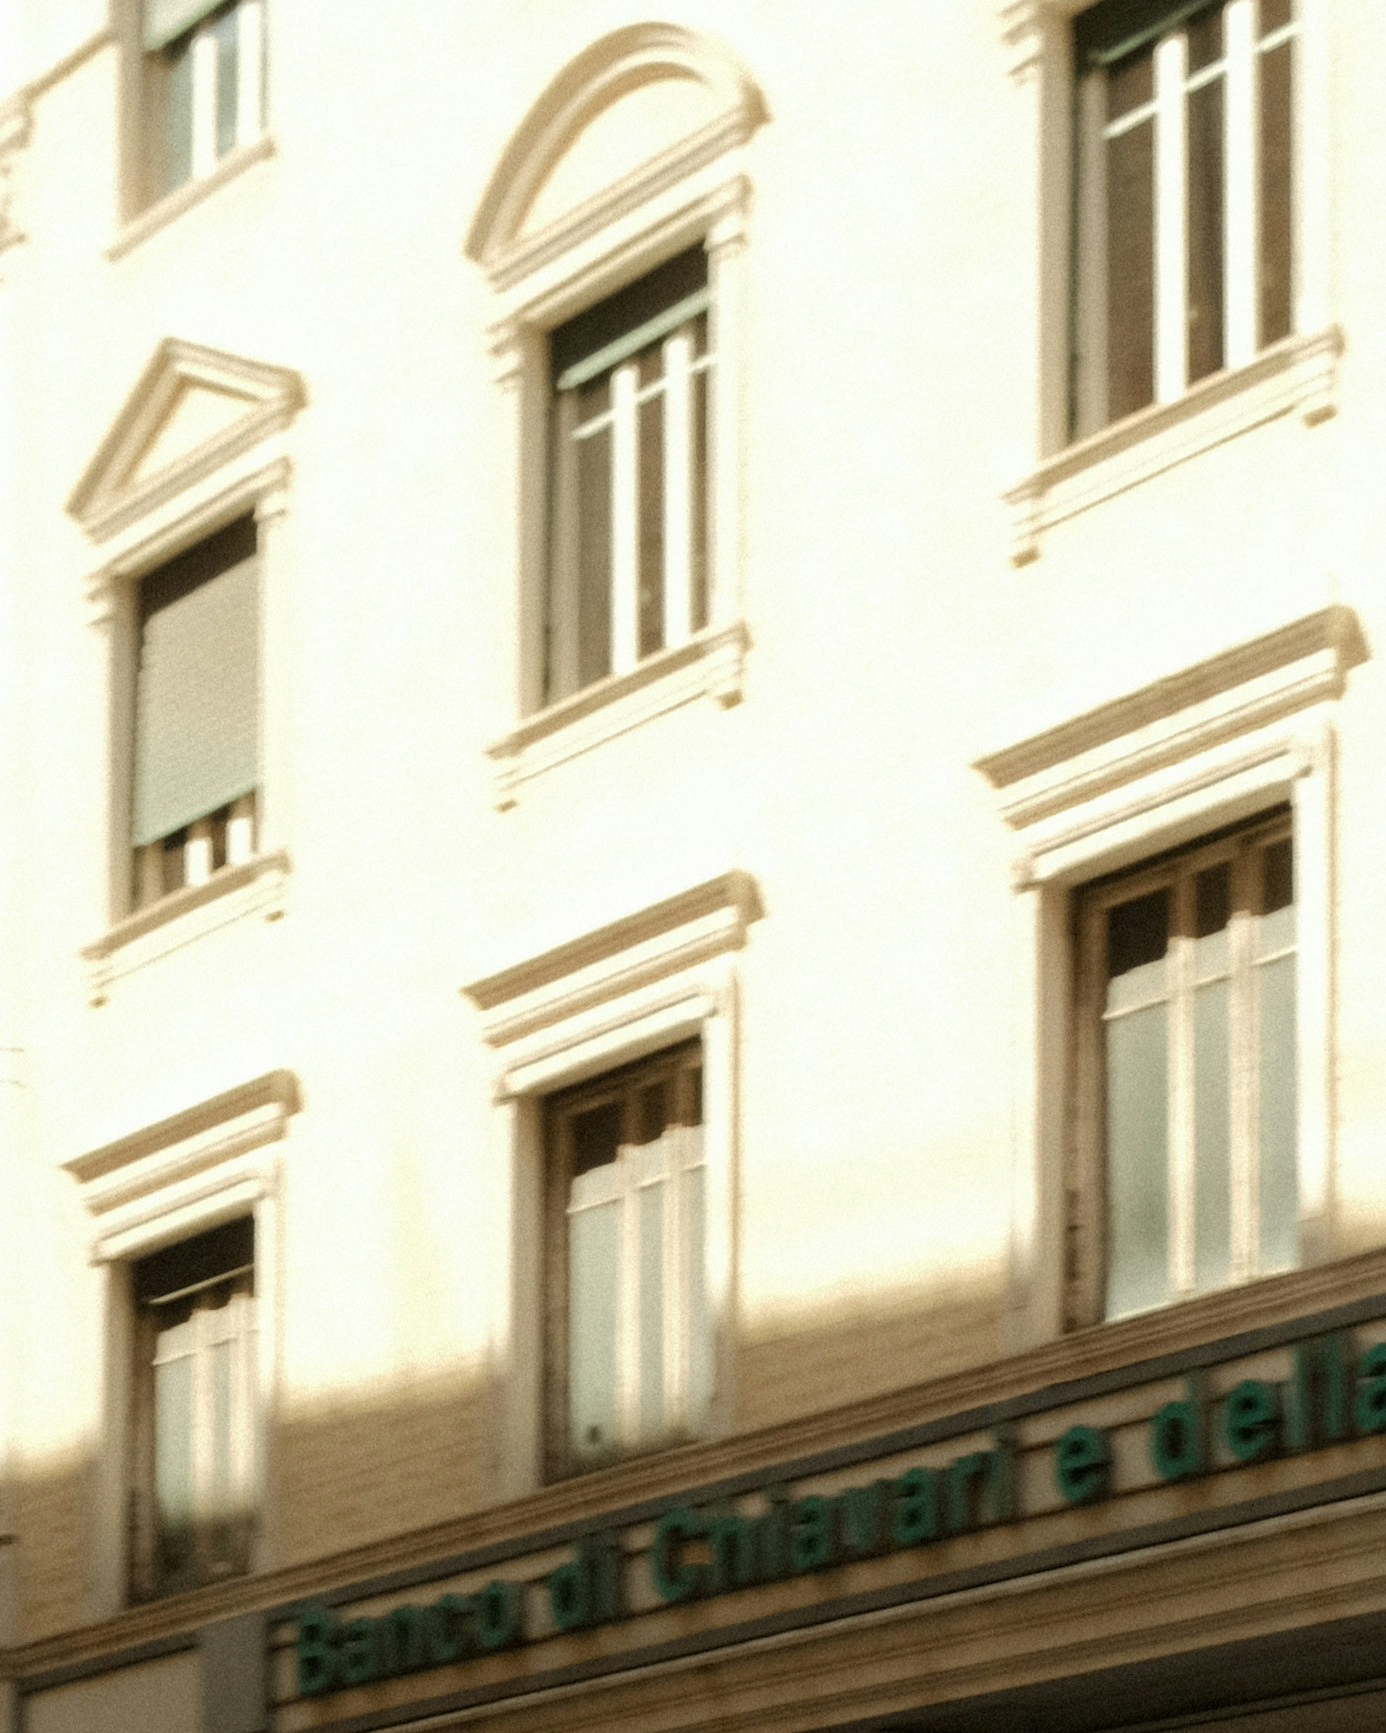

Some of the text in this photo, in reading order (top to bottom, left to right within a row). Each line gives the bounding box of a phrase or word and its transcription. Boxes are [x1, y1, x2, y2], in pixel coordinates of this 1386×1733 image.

[293, 1582, 521, 1698] Banco
[547, 1532, 621, 1632] di
[650, 1428, 1017, 1604] Chiavari
[1053, 1422, 1111, 1504] e
